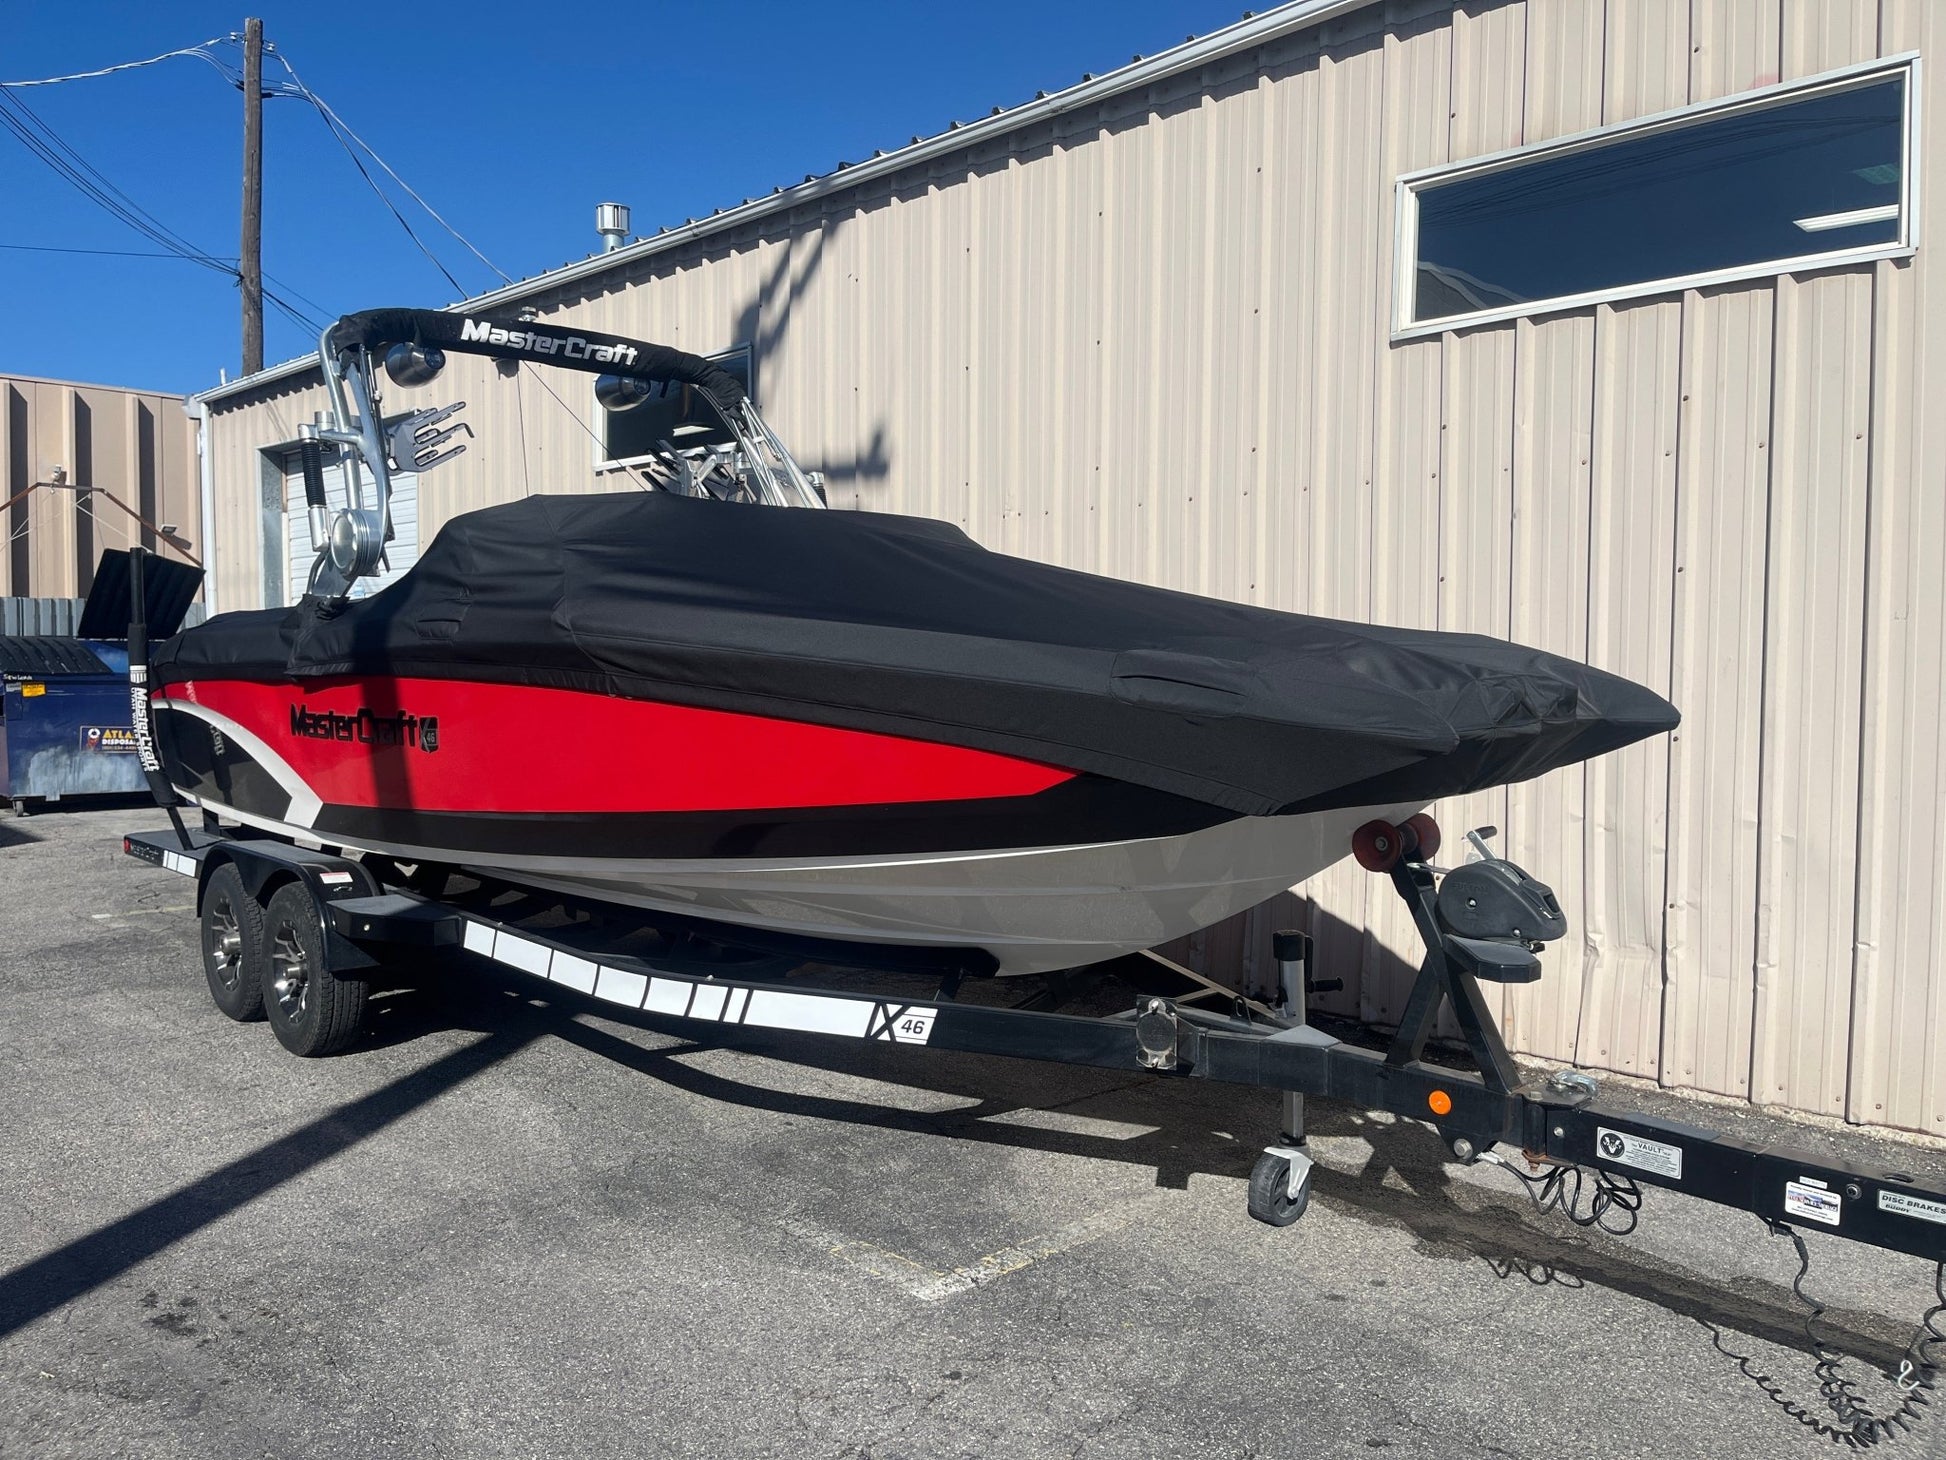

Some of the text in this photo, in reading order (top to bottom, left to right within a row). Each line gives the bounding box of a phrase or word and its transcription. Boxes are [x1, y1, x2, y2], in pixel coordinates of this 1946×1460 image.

[460, 318, 638, 366] MasterCraft
[102, 729, 136, 739] ATLA
[136, 687, 160, 772] MasterCraft
[290, 703, 417, 747] MasterCraft
[901, 1019, 926, 1035] 46
[1637, 1142, 1662, 1154] VAULT
[1882, 1194, 1905, 1205] DISC
[1907, 1200, 1946, 1215] BRAKES
